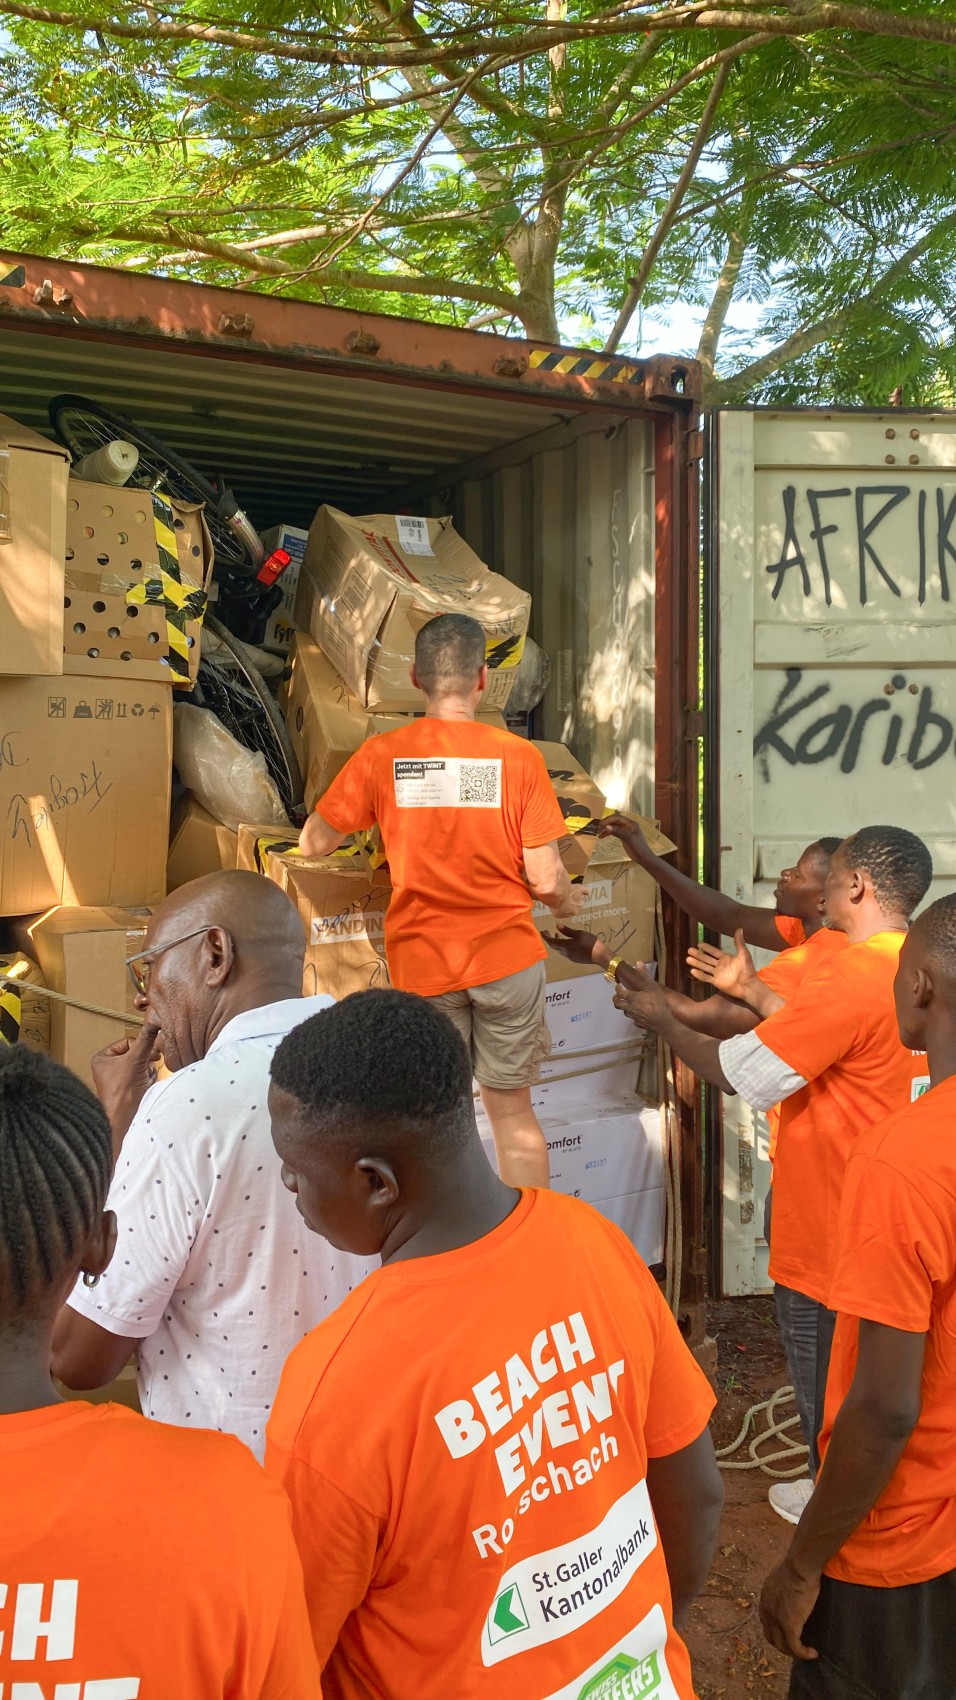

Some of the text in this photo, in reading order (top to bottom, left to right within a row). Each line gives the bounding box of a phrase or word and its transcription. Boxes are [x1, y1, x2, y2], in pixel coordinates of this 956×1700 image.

[753, 667, 956, 783] Karib
[572, 906, 630, 924] expect more.
[434, 1311, 596, 1460] BEACH
[472, 1432, 619, 1559] Roschach
[540, 1518, 650, 1623] Kantonalbank
